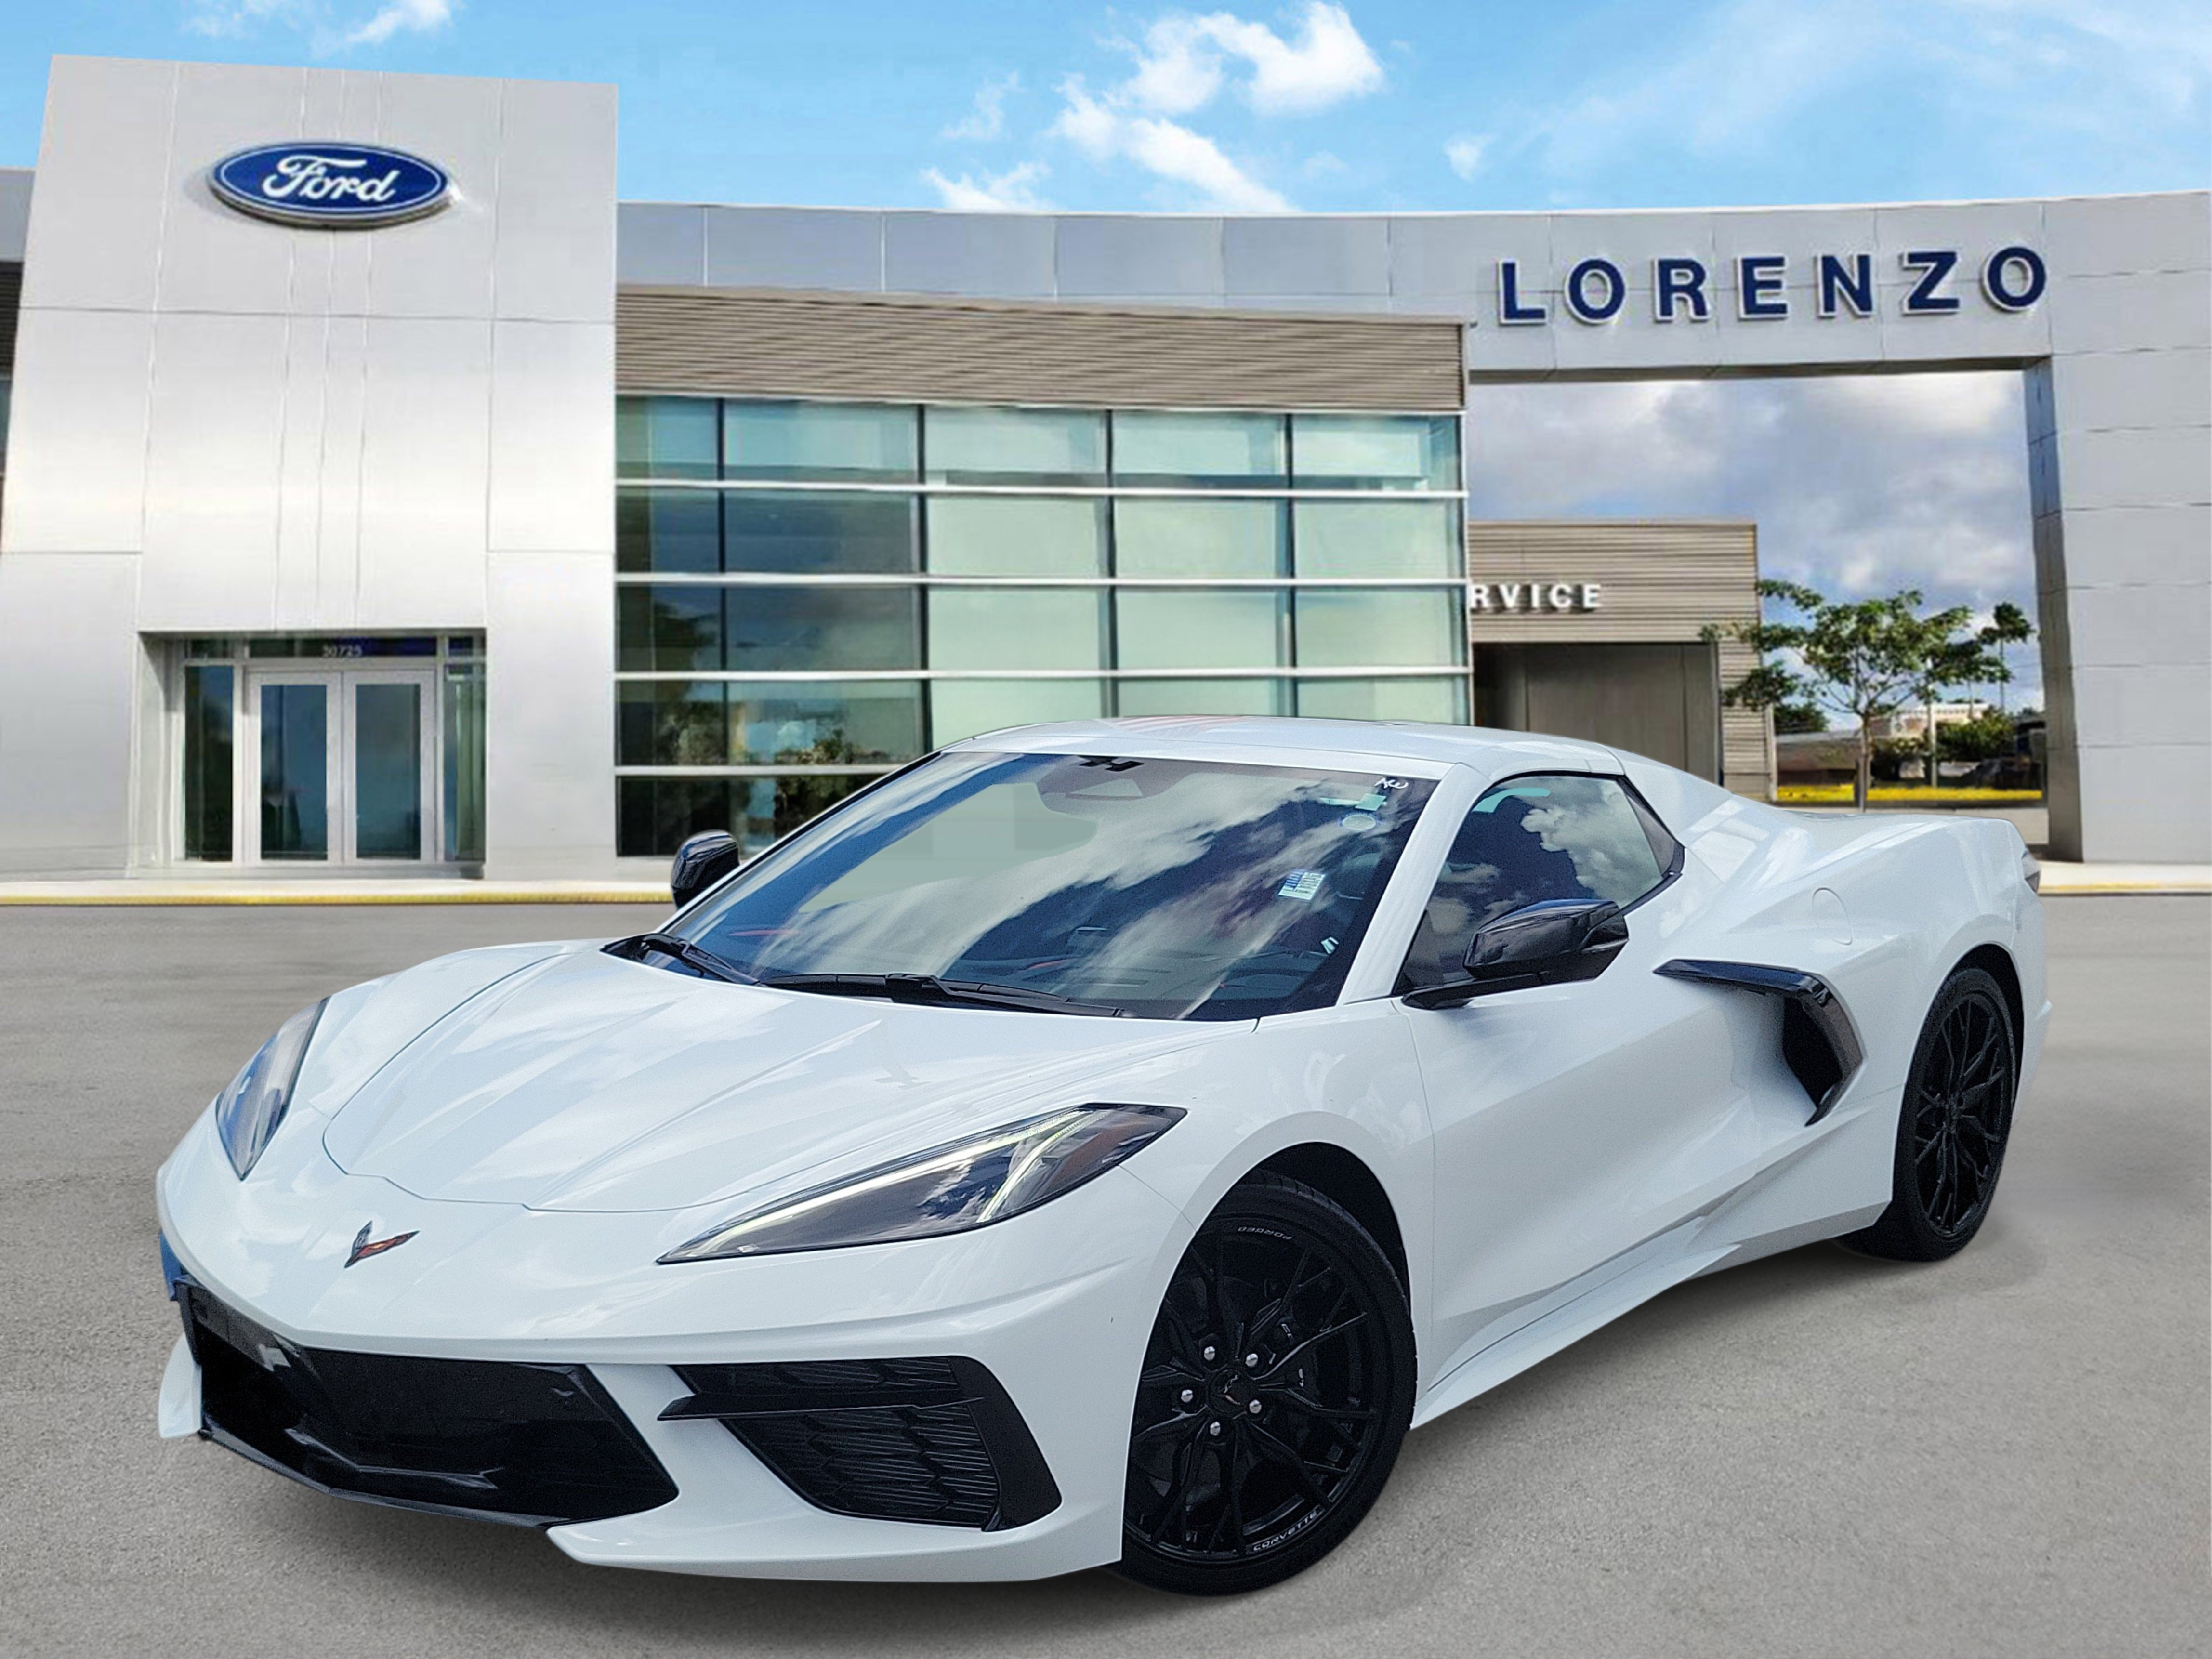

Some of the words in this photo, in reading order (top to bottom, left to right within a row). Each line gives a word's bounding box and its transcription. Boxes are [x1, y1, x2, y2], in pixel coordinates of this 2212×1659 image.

[262, 155, 400, 201] Ford
[1499, 246, 2047, 323] LORENZO
[1253, 1510, 1317, 1551] CORVETTE
